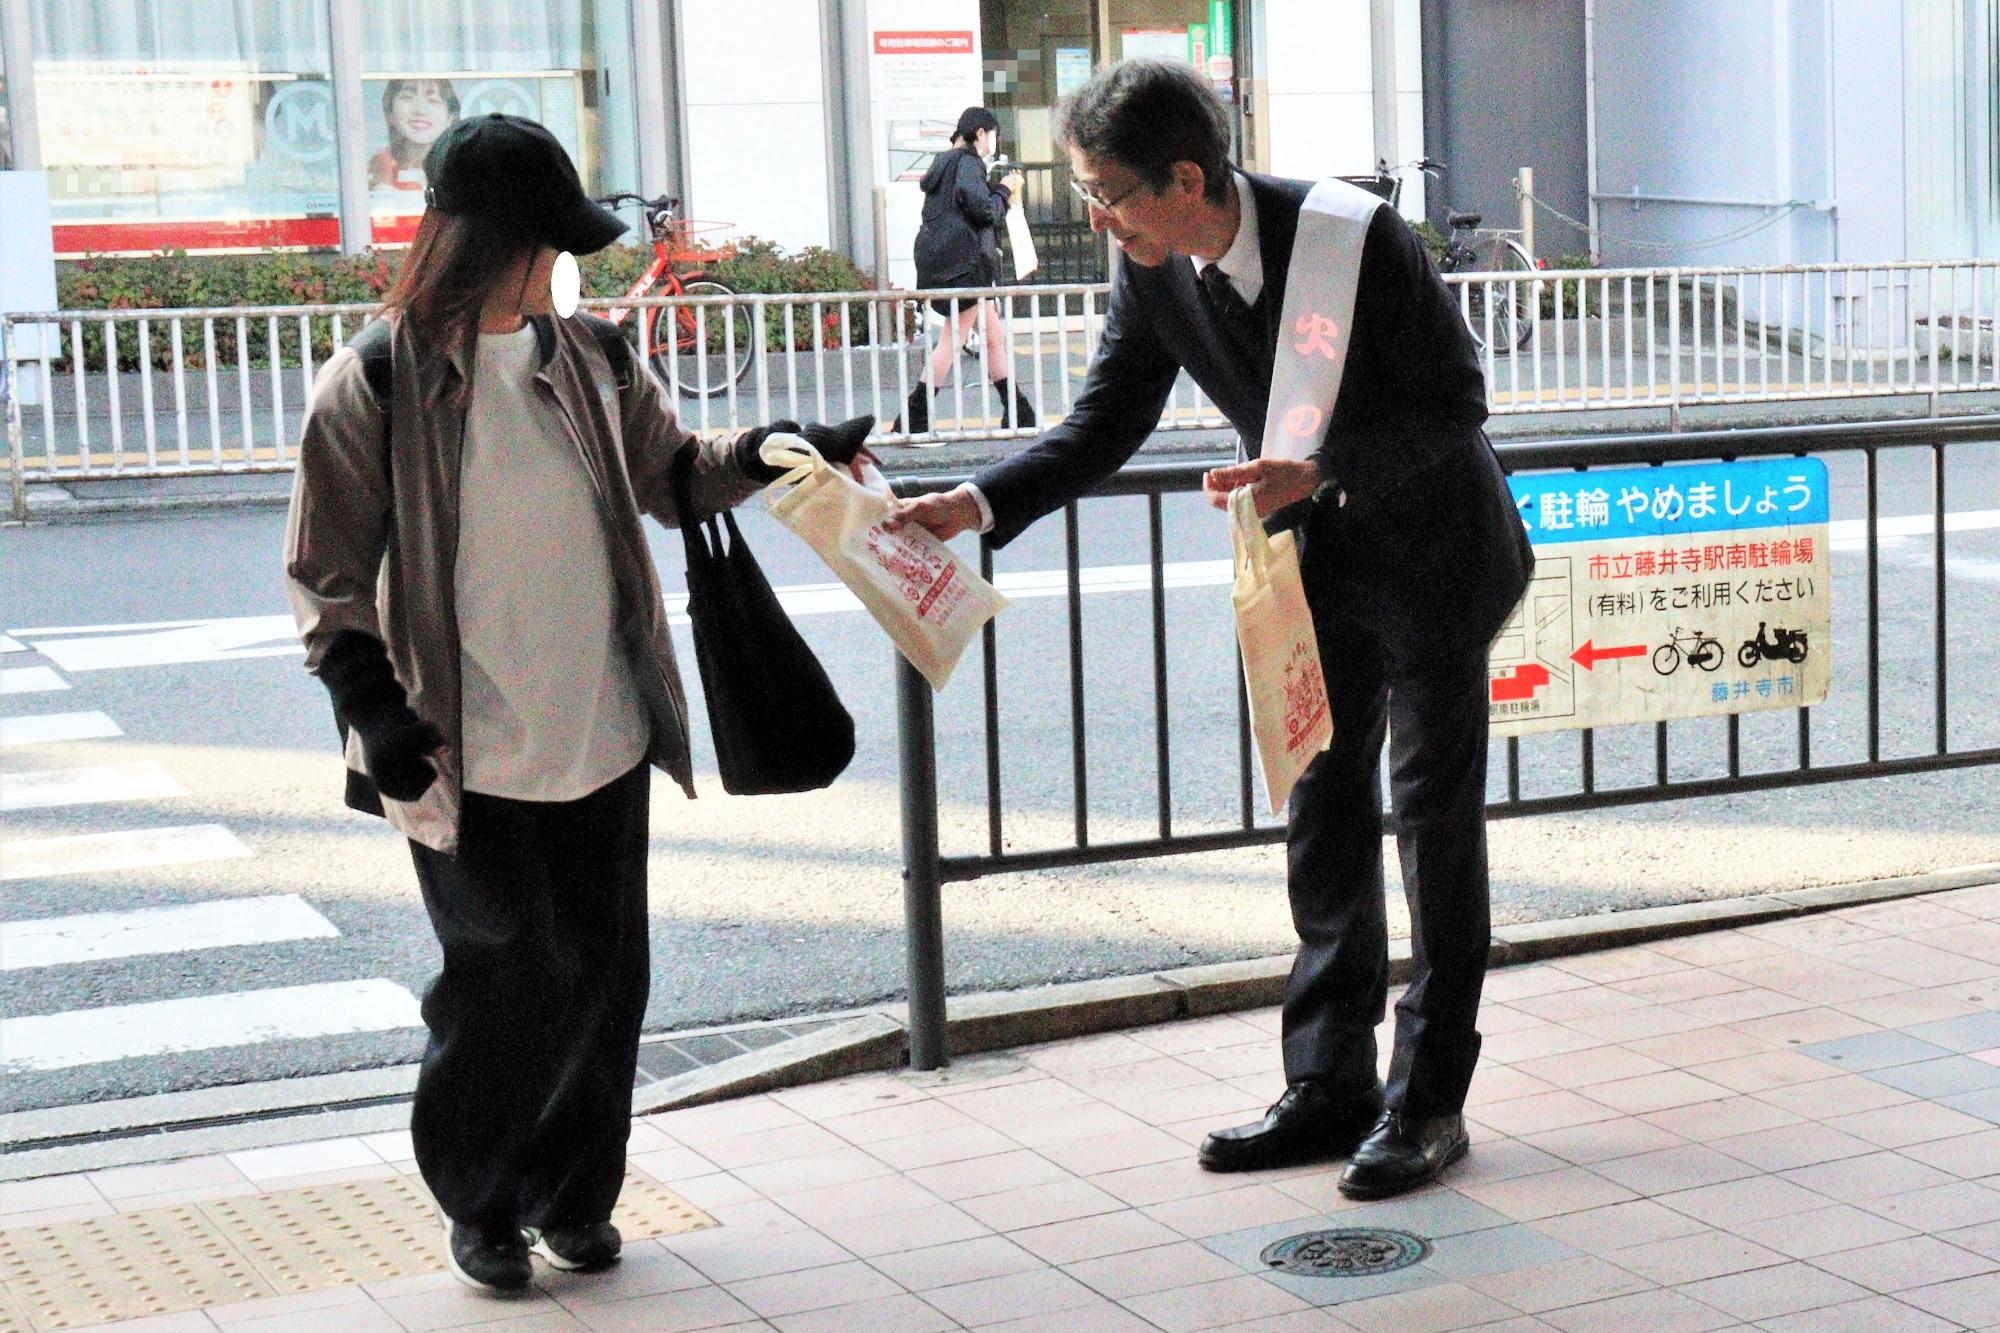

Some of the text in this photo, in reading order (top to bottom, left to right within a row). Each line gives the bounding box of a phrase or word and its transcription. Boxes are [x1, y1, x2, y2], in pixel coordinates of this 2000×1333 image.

[1588, 538, 1814, 580] 市立藤井寺駅南駐輪場
[1588, 577, 1814, 617] (有料)をご利用ください
[1711, 676, 1794, 703] 藤井寺市
